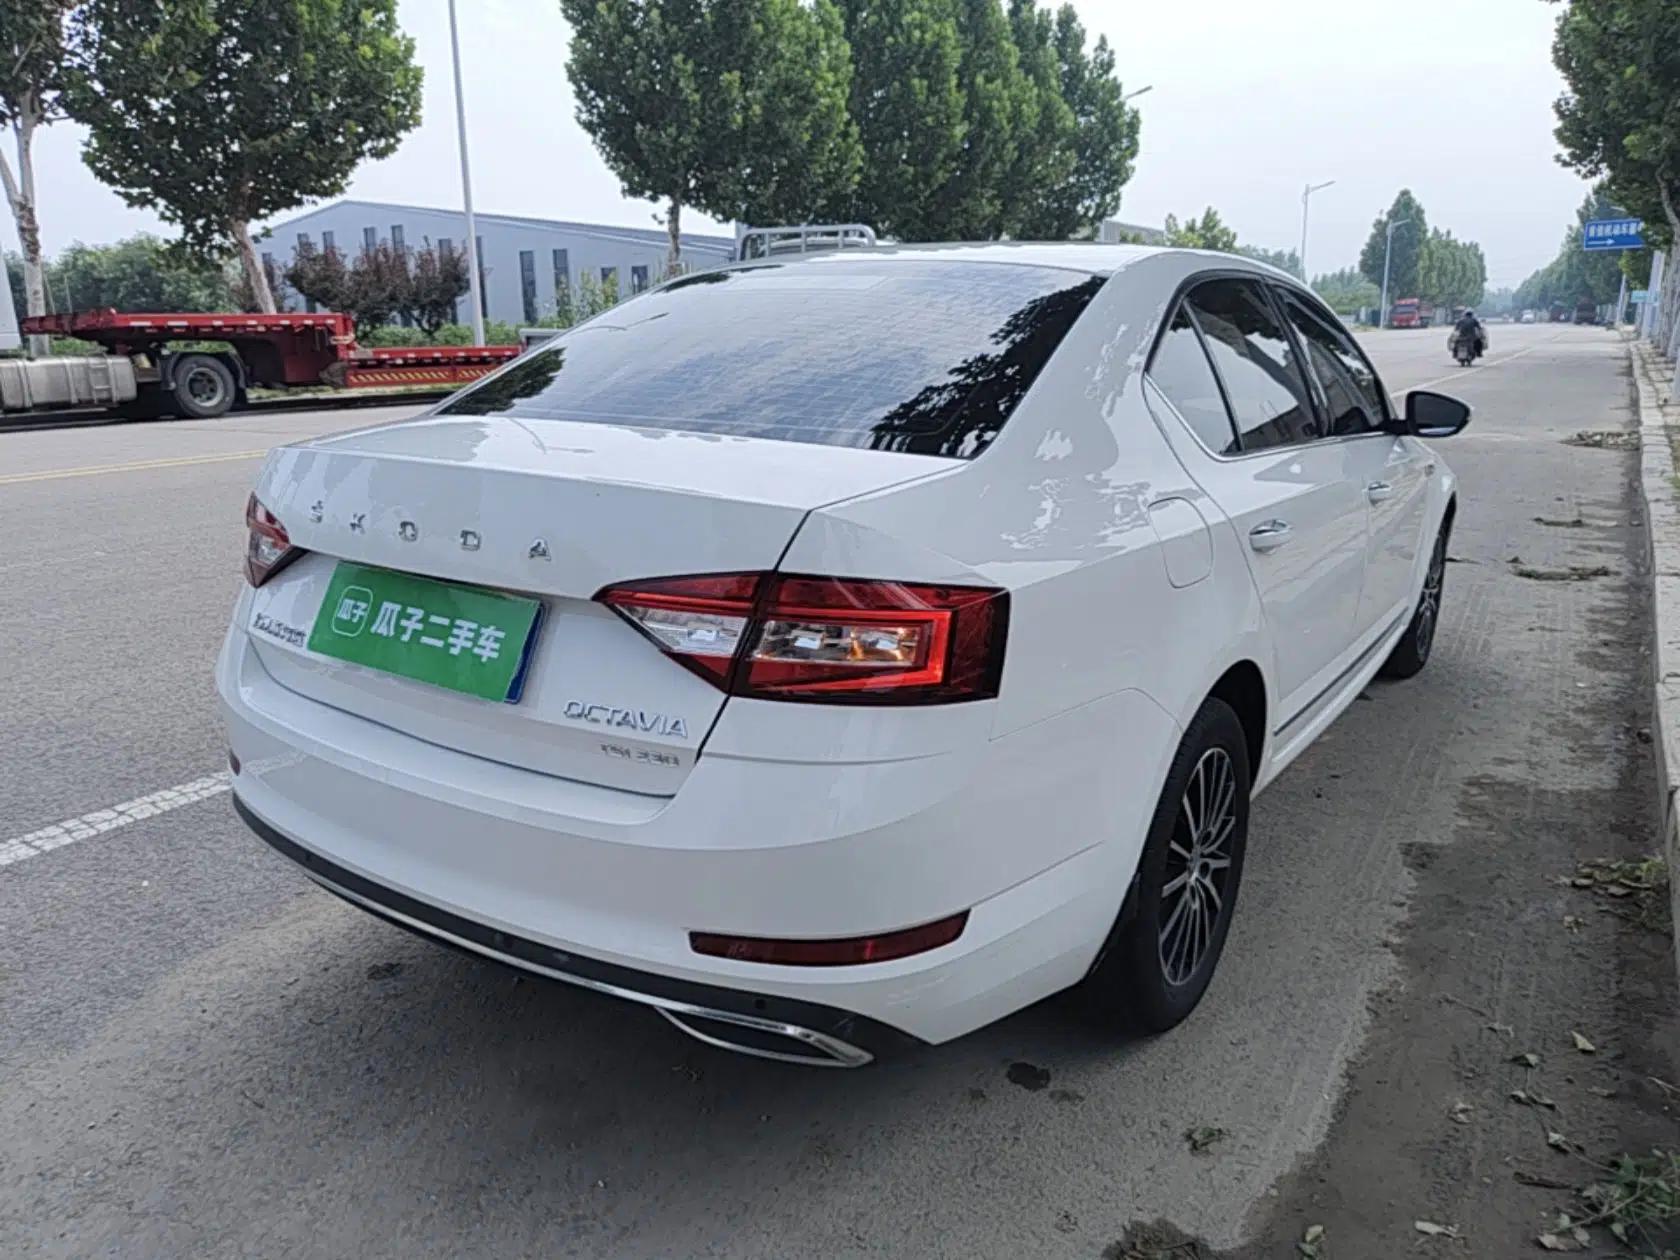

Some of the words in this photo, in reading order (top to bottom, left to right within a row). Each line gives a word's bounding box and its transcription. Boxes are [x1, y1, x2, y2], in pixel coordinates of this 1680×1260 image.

[336, 597, 369, 624] 瓜子
[369, 600, 506, 663] 瓜子二手车
[562, 699, 688, 740] OCTAVIA
